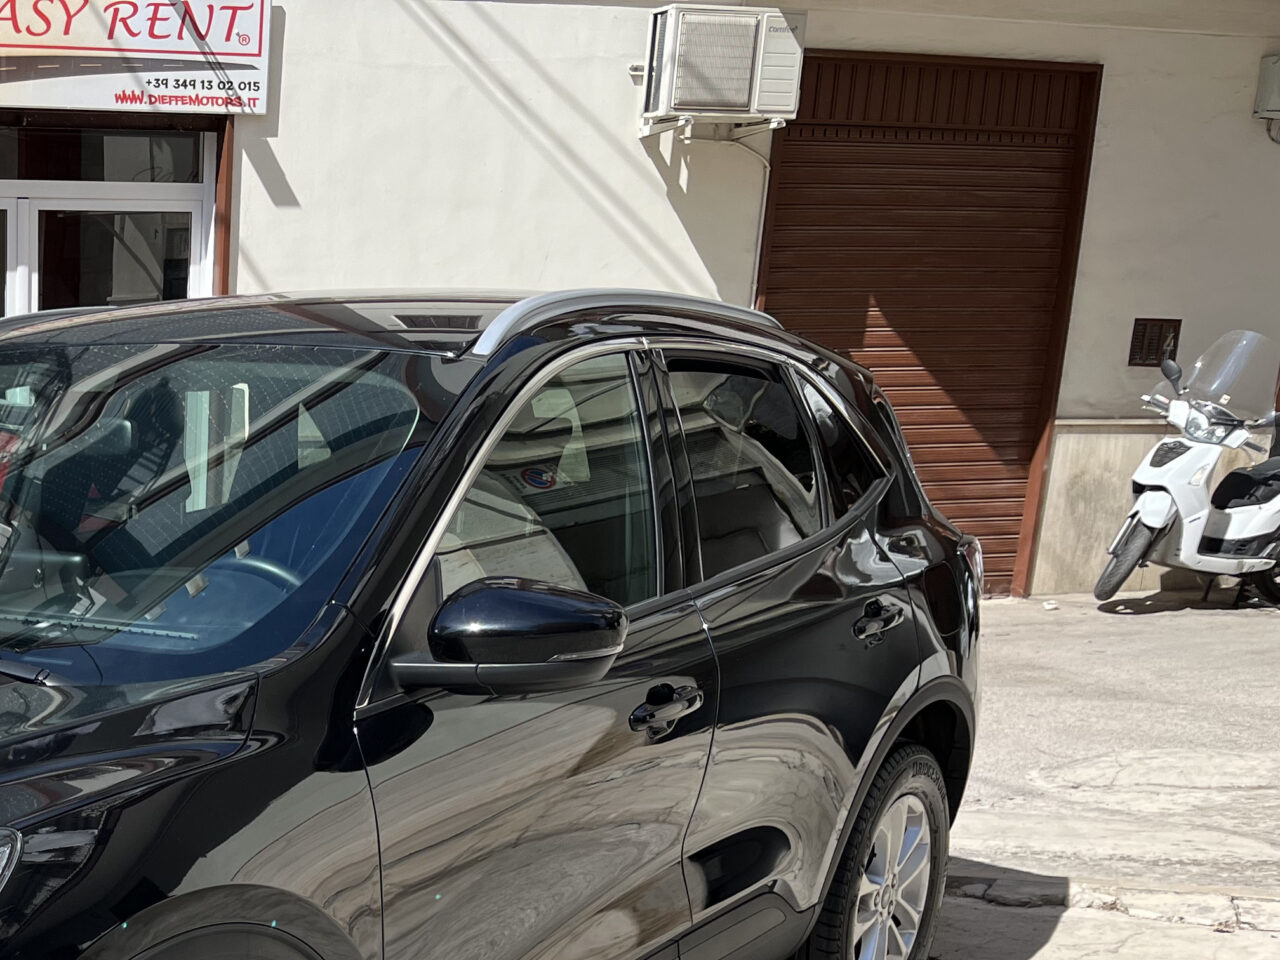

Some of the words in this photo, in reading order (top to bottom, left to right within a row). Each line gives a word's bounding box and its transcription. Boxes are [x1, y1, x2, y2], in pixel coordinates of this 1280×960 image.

[145, 78, 169, 89] +39
[173, 79, 196, 90] 349
[200, 80, 214, 90] 13
[217, 80, 234, 91] 02
[238, 81, 260, 92] 015
